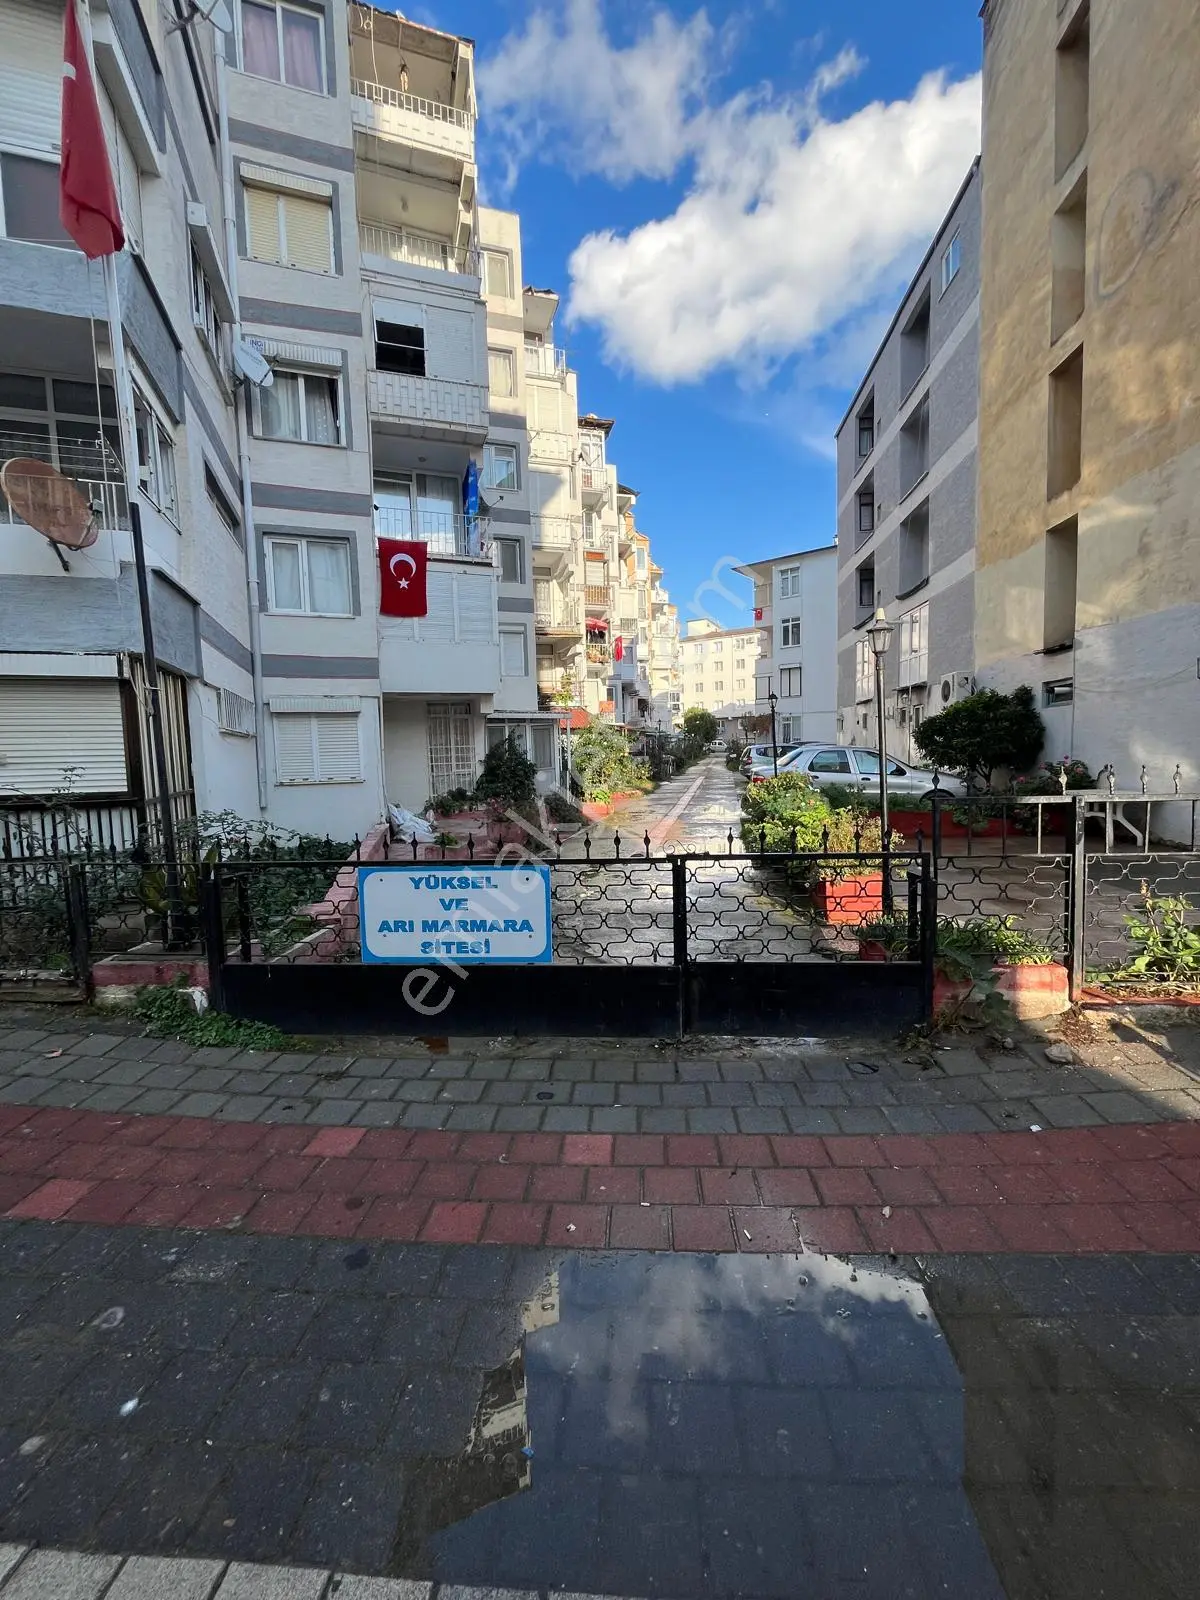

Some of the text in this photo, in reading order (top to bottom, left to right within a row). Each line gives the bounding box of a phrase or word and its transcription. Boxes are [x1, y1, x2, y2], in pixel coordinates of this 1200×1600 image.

[409, 874, 498, 890] YÜKSEL
[438, 898, 469, 911] VE
[378, 919, 534, 933] ARI MARMARA
[420, 938, 491, 954] SİTESİ
